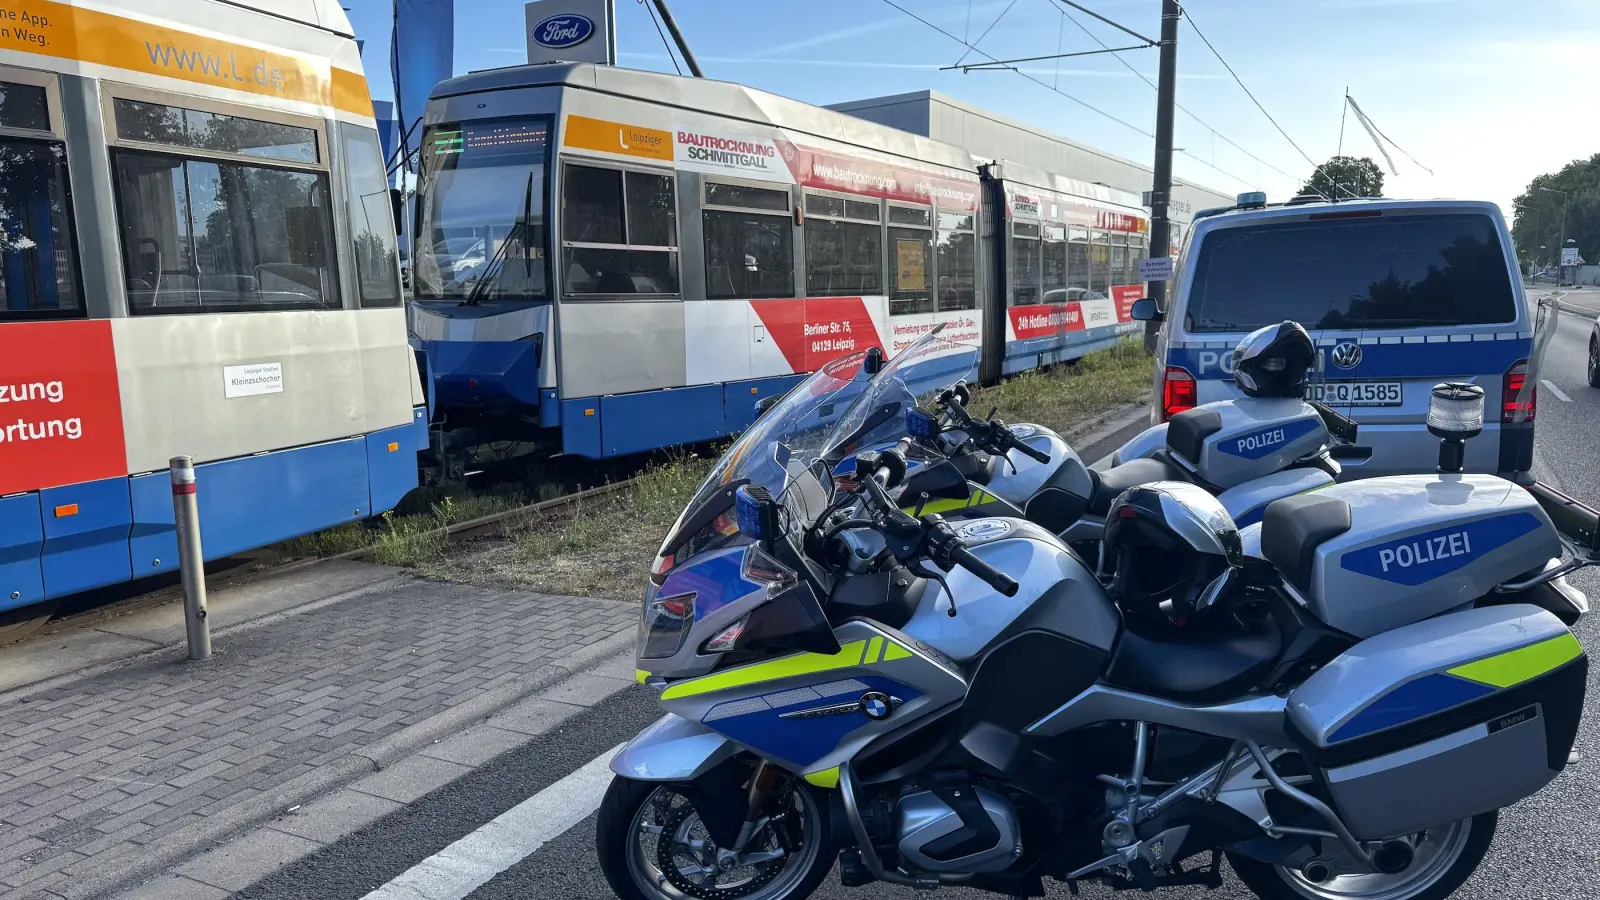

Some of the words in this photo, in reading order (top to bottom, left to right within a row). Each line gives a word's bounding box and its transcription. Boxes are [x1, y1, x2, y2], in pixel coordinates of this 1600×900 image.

[21, 10, 53, 28] App.
[13, 27, 50, 46] Weg.
[543, 20, 579, 41] Ford
[144, 40, 284, 89] www.L.de
[629, 130, 662, 146] Leipziger
[677, 131, 775, 158] BAUTROCKNUNG
[688, 146, 768, 169] SCHMITTGALL
[804, 324, 829, 336] Berliner
[830, 322, 841, 333] Str.
[893, 325, 919, 335] Vermietung
[920, 324, 929, 332] von
[1018, 317, 1028, 330] 24h
[1029, 314, 1048, 328] Hotline
[812, 340, 832, 352] 04129
[832, 337, 855, 351] Leipzig
[231, 375, 281, 386] Kleinzschocher
[0, 381, 64, 403] zung
[1337, 385, 1349, 401] Q
[1353, 385, 1399, 400] 1585
[1237, 428, 1285, 453] POLIZEI
[1379, 531, 1471, 572] POLIZEI
[1500, 711, 1526, 728] BMW
